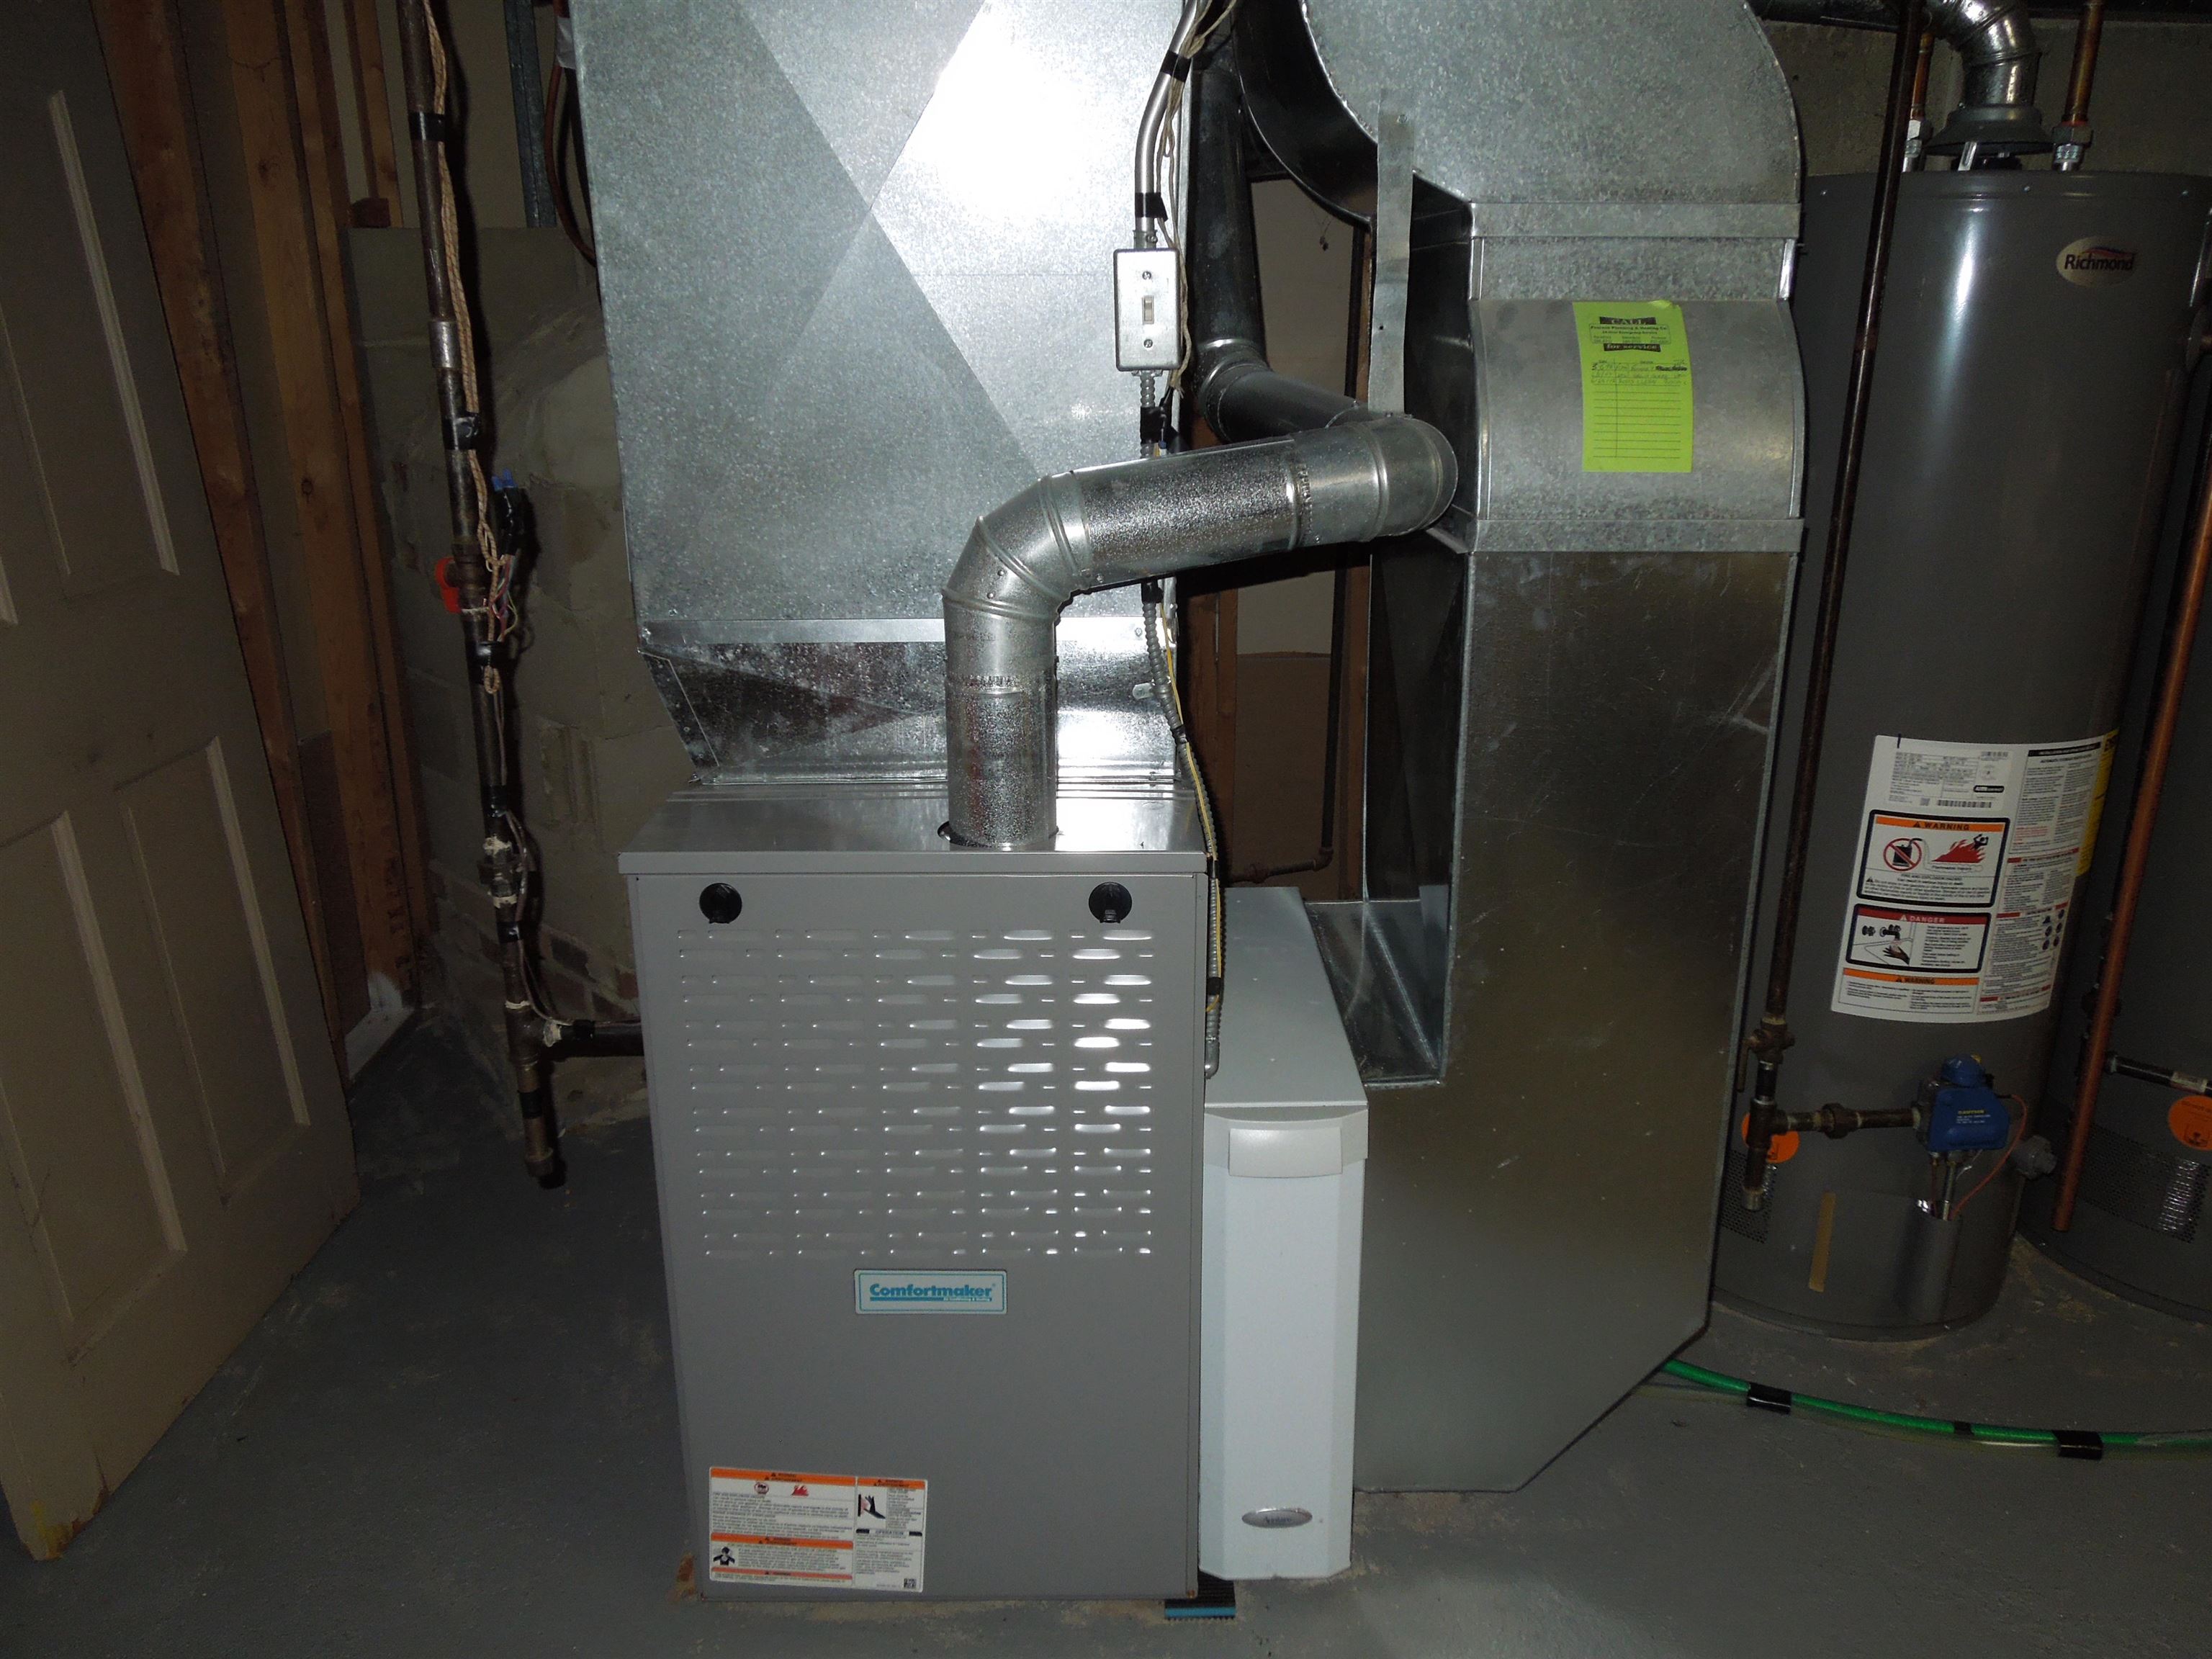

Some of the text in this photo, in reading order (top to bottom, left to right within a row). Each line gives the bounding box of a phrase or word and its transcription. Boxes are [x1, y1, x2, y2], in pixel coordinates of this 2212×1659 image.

[2064, 253, 2135, 270] Richmond
[1923, 821, 1970, 831] WARNING
[869, 1283, 992, 1296] Comfortmaker
